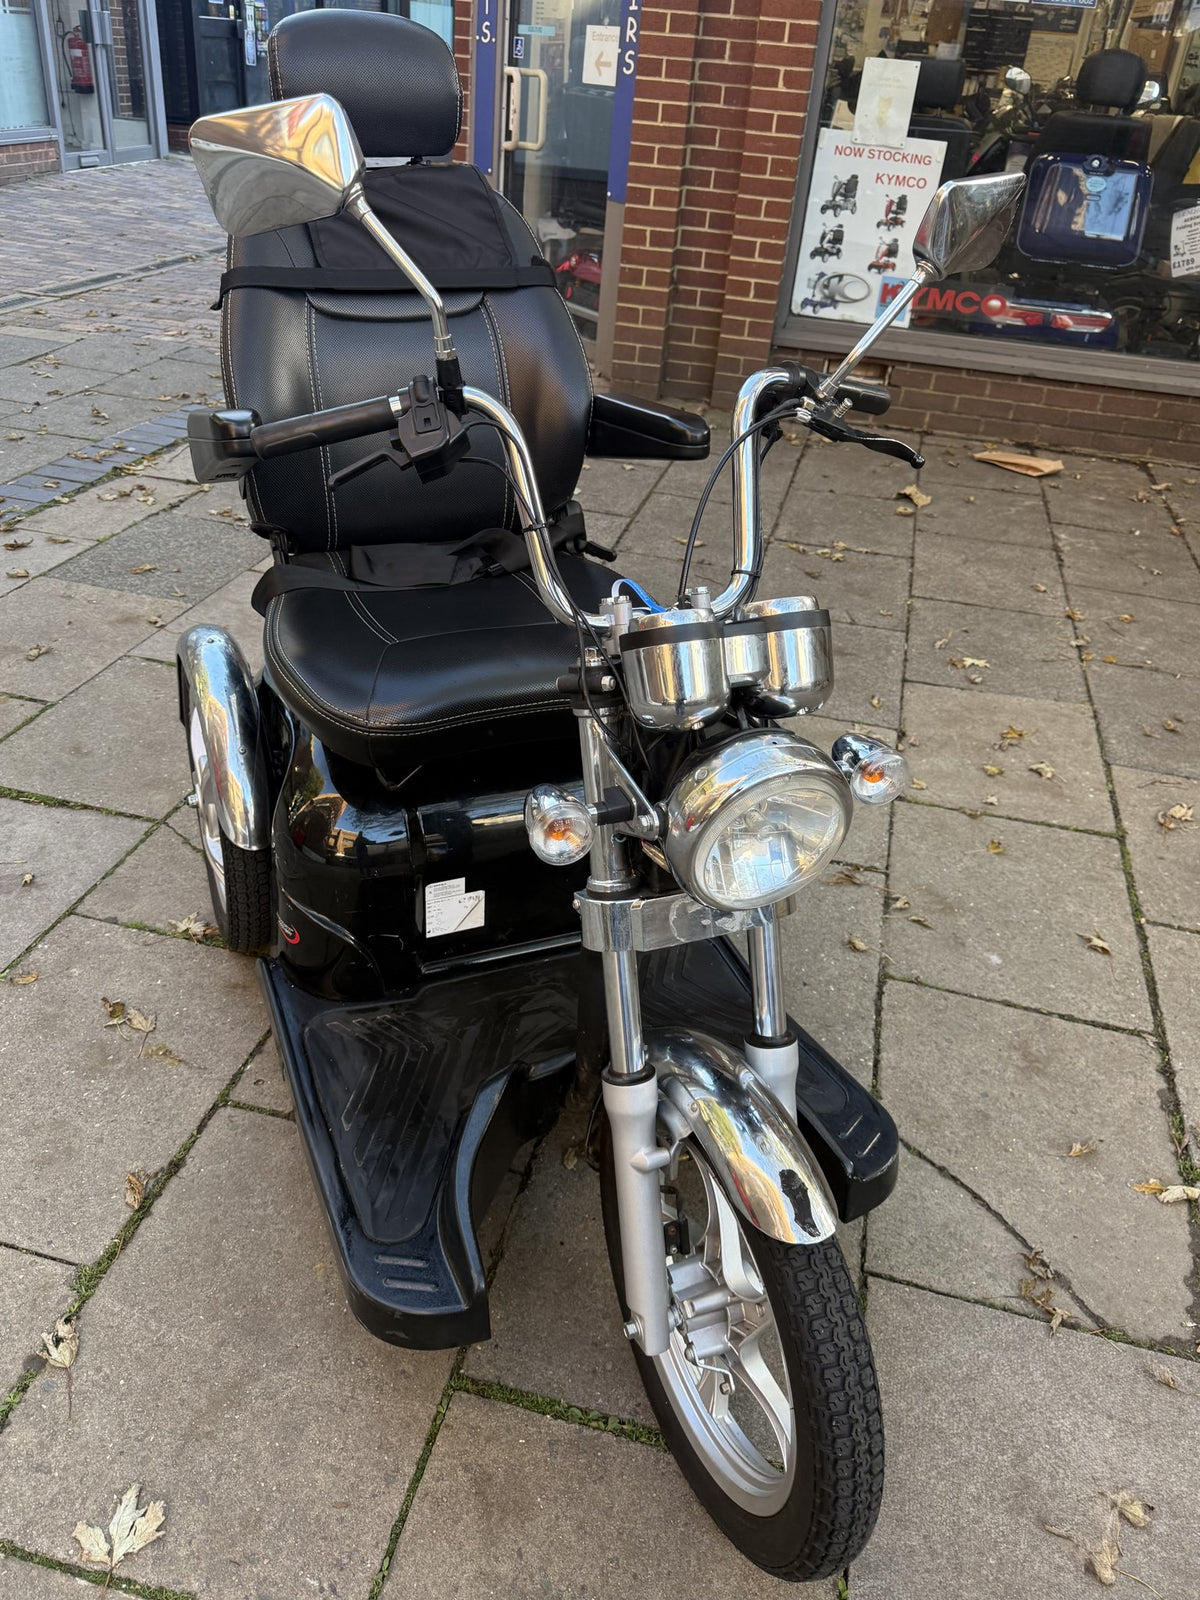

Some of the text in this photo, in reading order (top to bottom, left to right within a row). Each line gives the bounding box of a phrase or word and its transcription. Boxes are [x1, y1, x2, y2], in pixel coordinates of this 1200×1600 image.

[834, 145, 932, 166] NOW STOCKING
[875, 172, 927, 189] KYMCO
